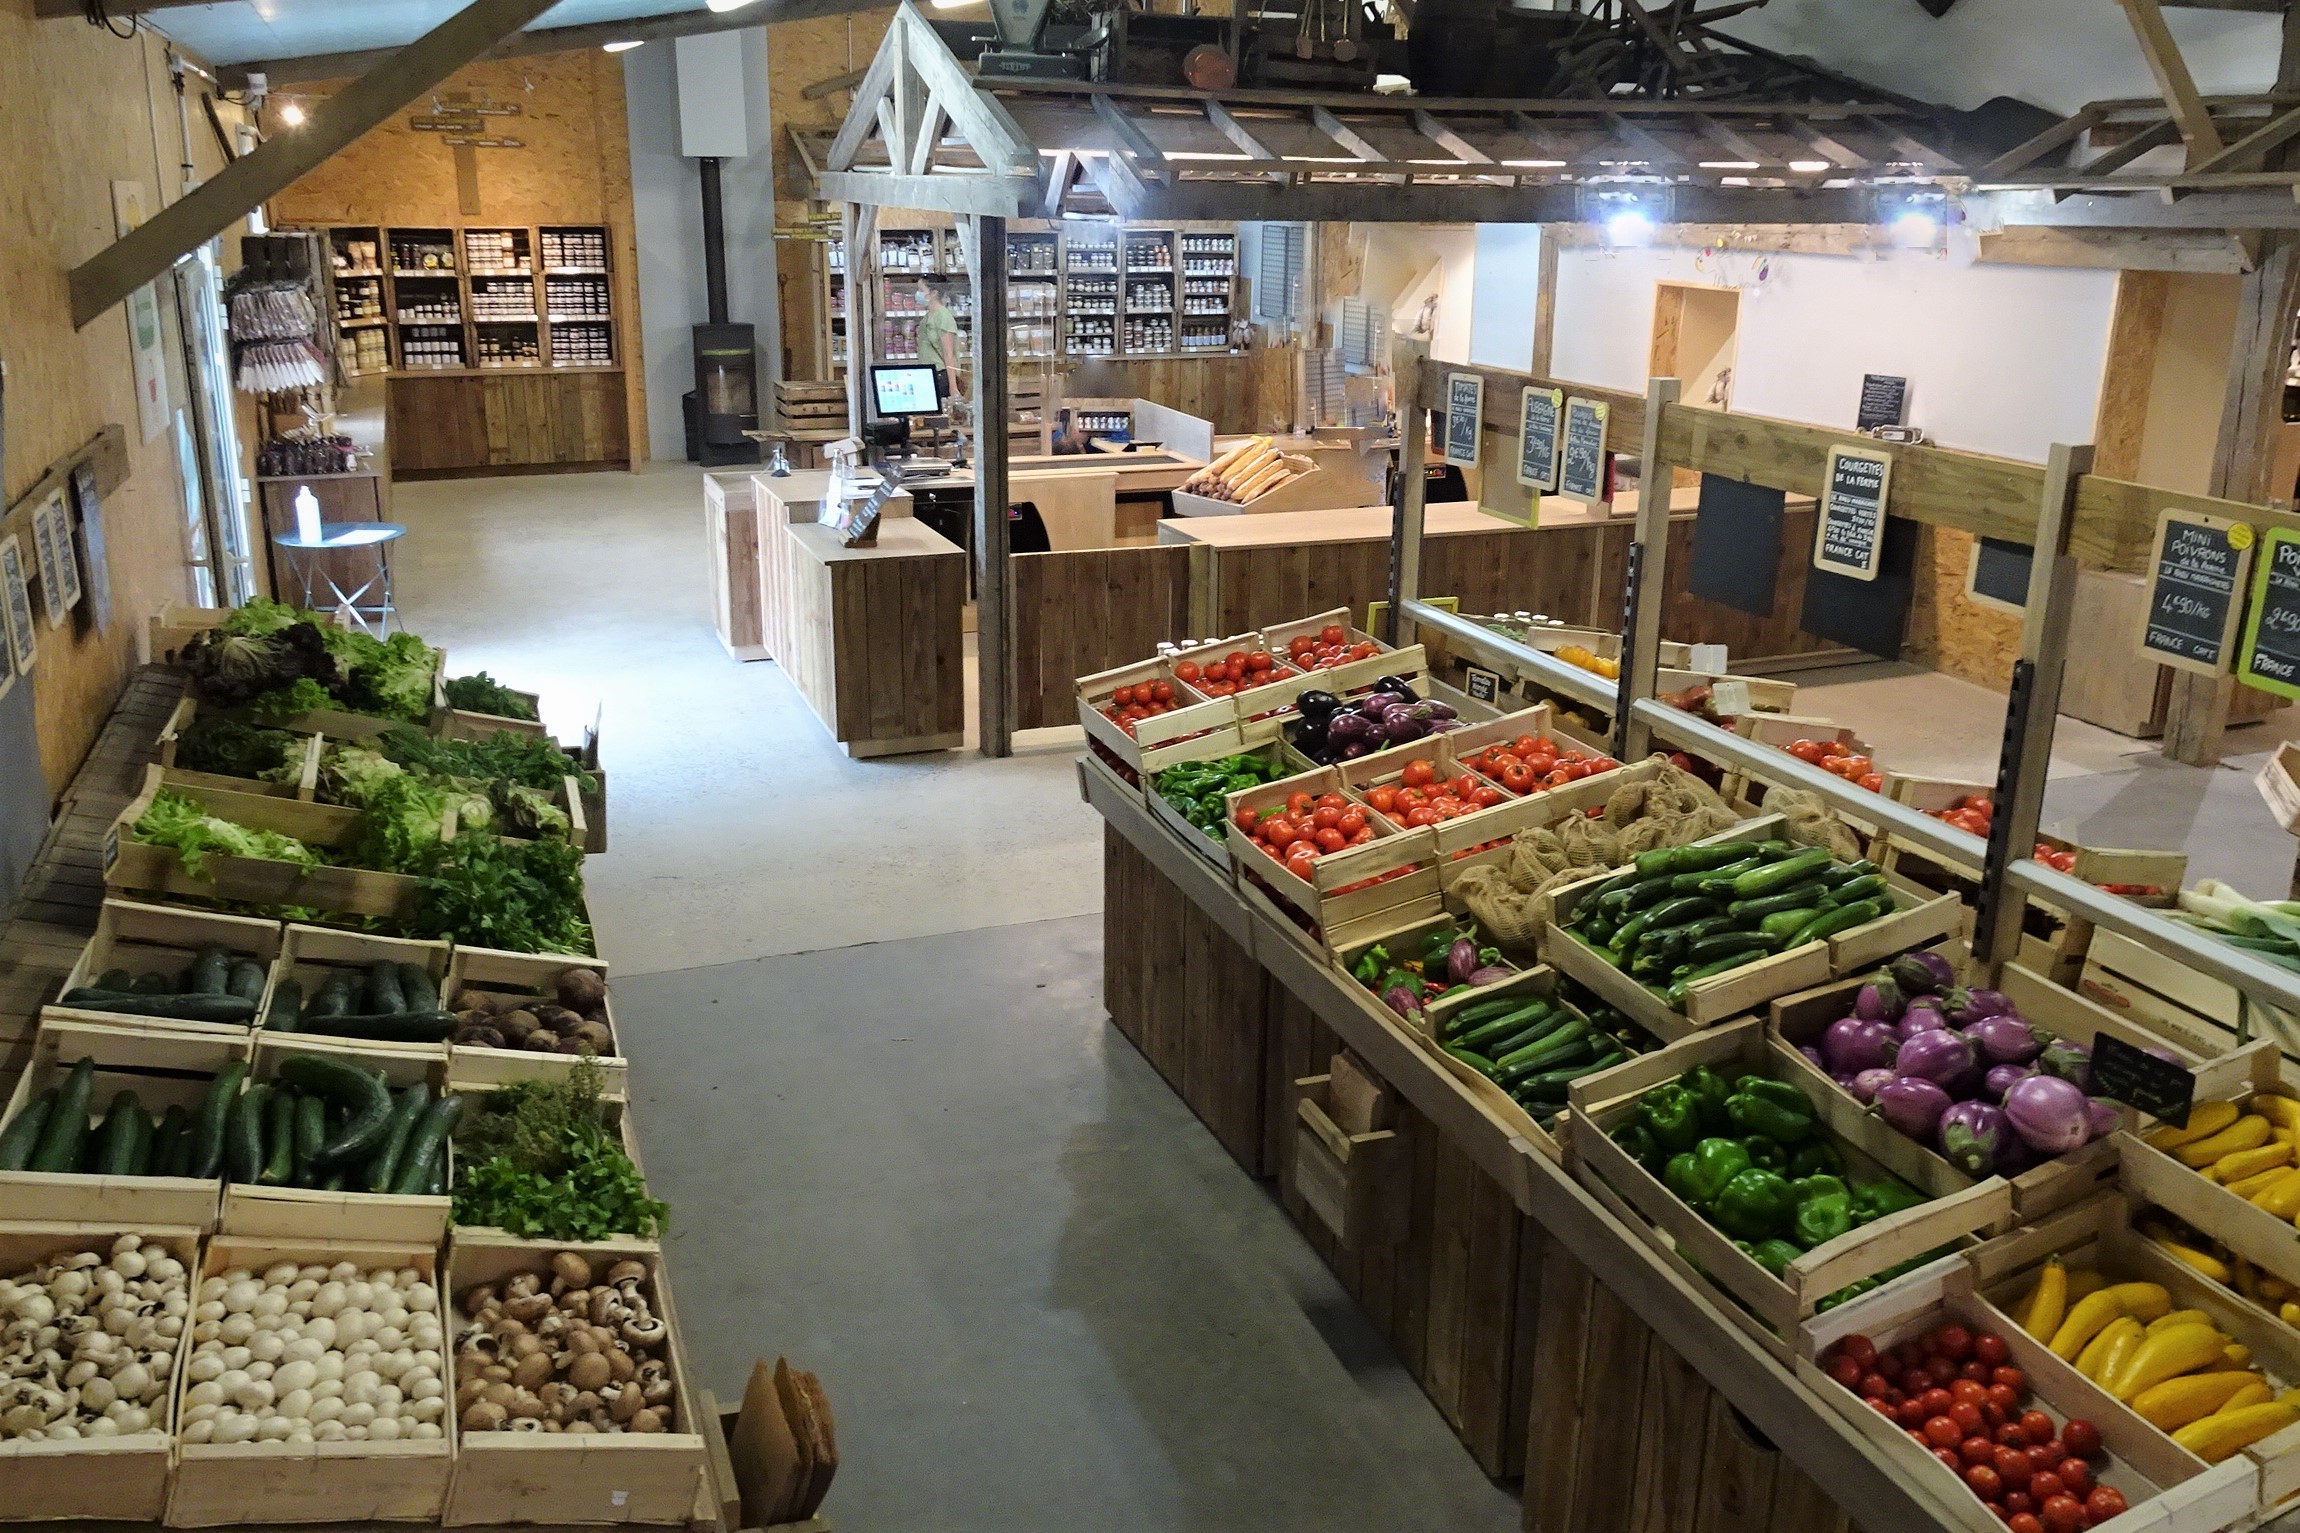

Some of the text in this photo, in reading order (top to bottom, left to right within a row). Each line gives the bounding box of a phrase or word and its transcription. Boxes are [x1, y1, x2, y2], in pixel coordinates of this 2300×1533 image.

[1839, 457, 1884, 477] COURGETTES
[1835, 472, 1880, 489] DE LA FERME
[1825, 543, 1869, 560] FRANCE CAT
[2171, 539, 2227, 564] POIVRONS
[2149, 631, 2183, 650] FRANCE
[2254, 652, 2296, 678] FRANCE
